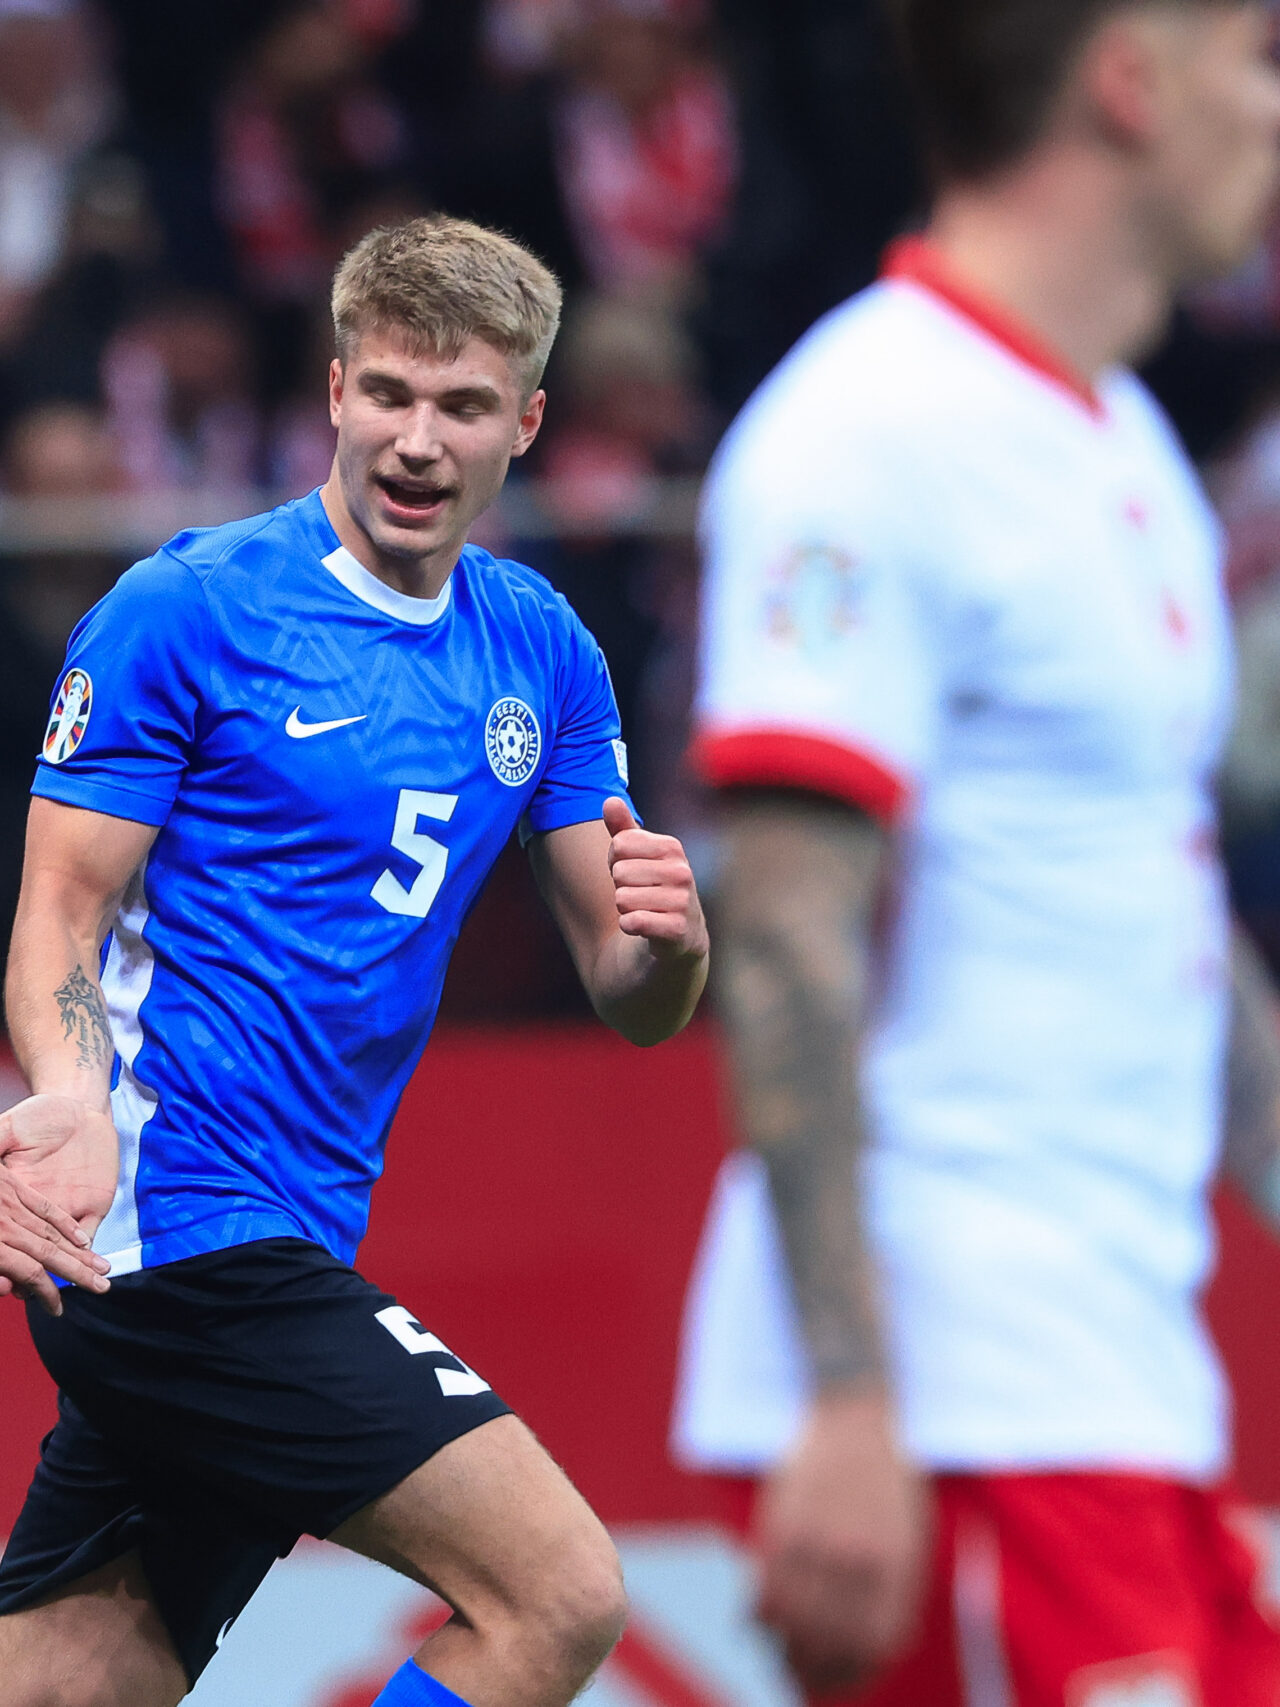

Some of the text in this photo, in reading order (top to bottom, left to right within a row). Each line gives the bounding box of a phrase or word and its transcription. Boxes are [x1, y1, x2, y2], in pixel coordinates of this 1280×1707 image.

[496, 702, 528, 721] EESTI
[487, 726, 528, 780] JALGPALLI
[370, 789, 459, 918] 5
[374, 1305, 493, 1397] 5
